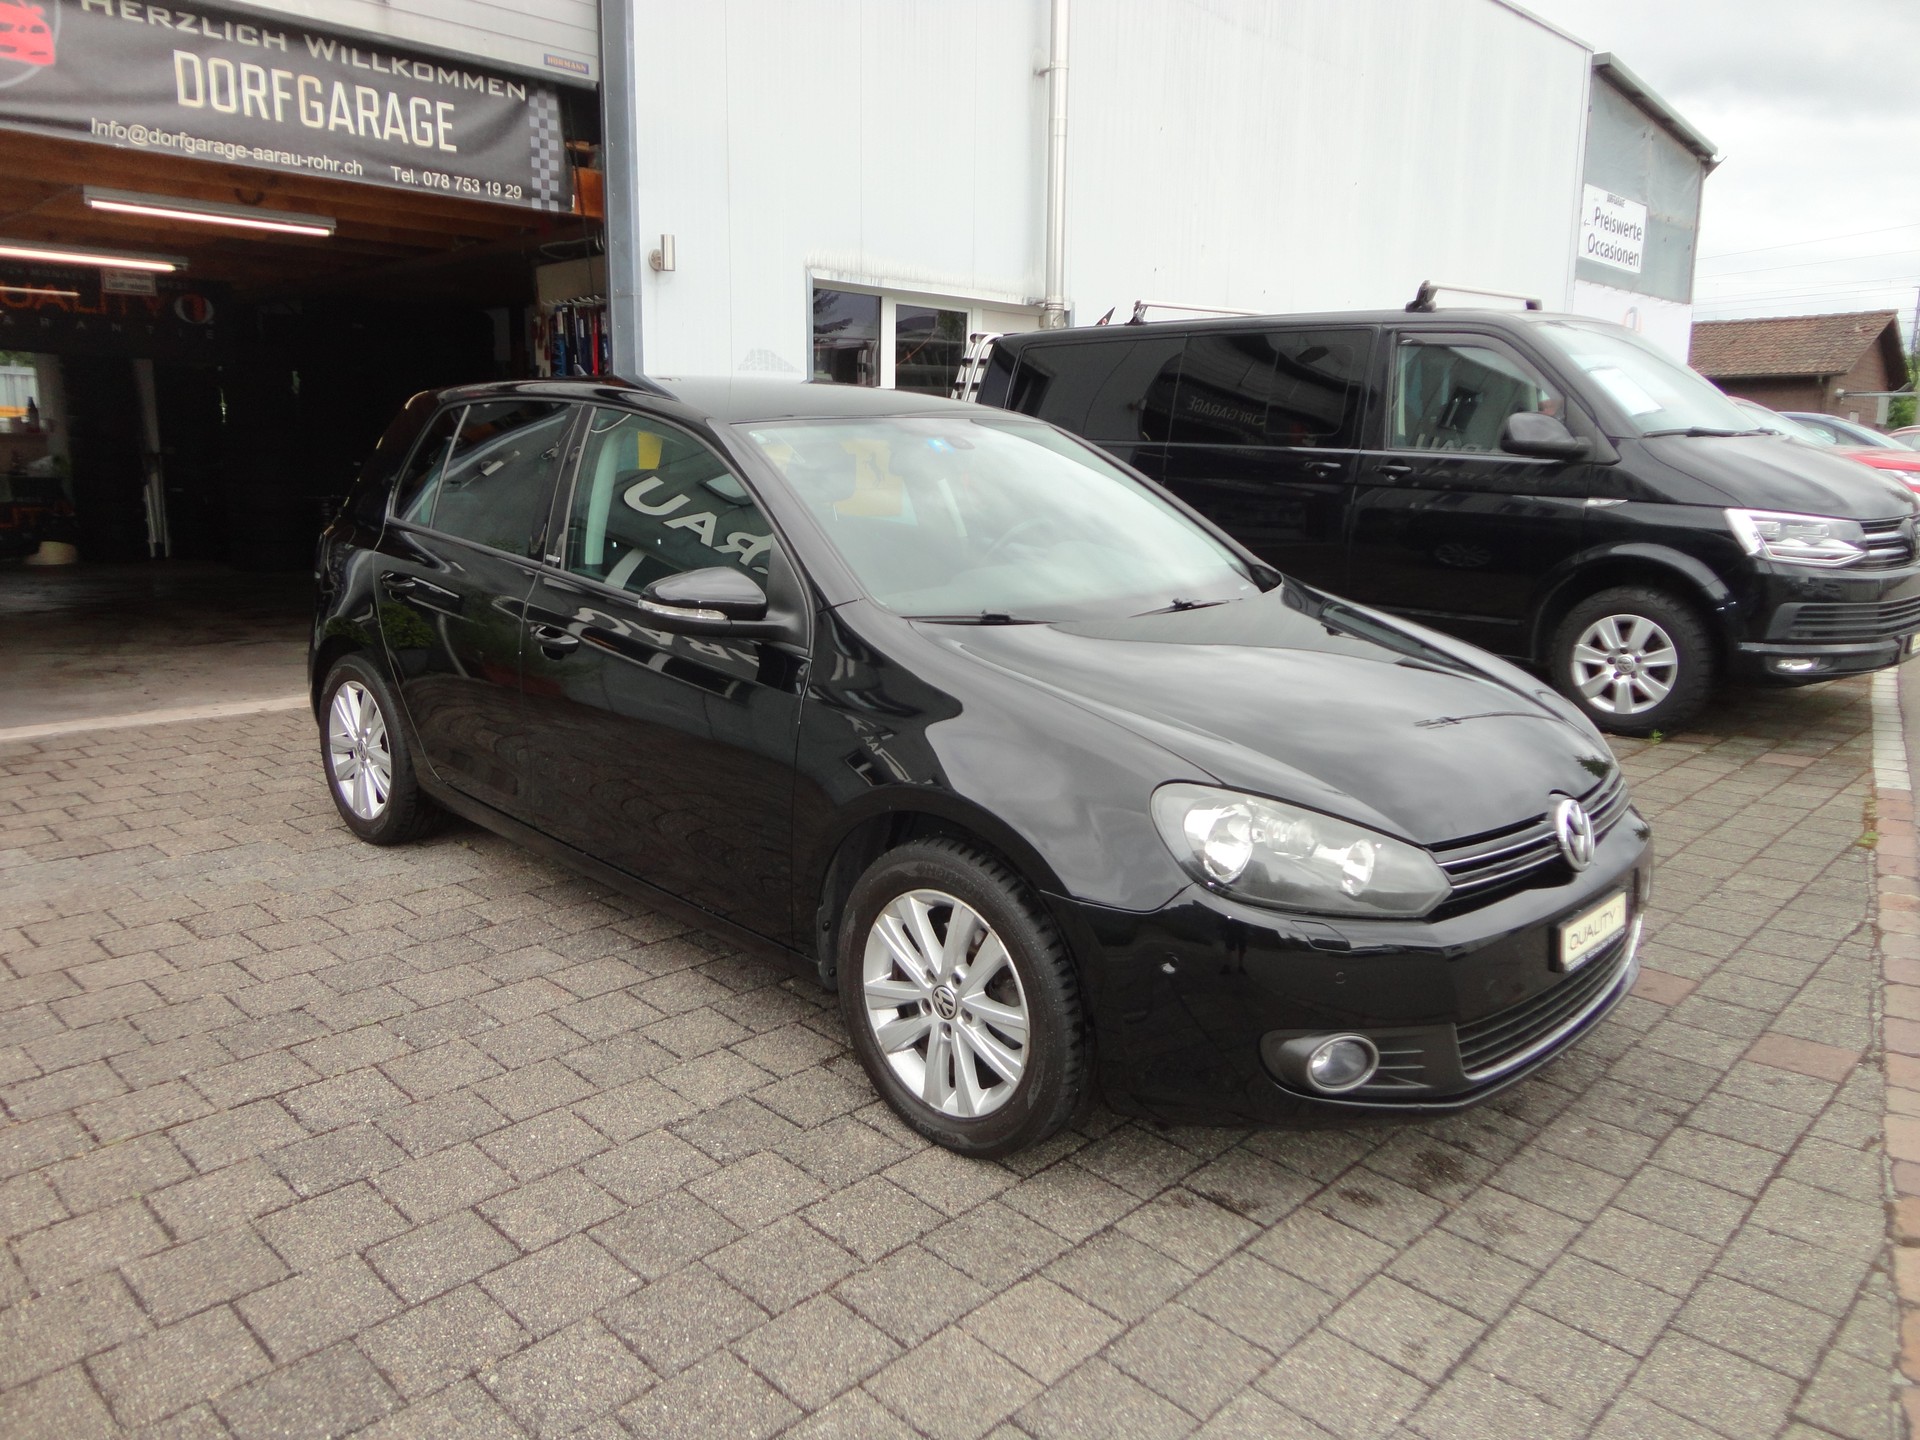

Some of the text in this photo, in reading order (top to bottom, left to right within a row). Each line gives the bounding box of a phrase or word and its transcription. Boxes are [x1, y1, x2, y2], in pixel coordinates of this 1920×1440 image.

[303, 33, 526, 101] WILLKOMMEN
[173, 49, 457, 153] DORFGARAGE
[90, 117, 363, 177] Info@dorfgarage-aarau-rohr.ch
[390, 165, 523, 200] Tel. 078 753 19 29
[1594, 206, 1643, 242] Preiswerte
[1587, 232, 1640, 267] Occasionen
[1570, 907, 1617, 951] QUALITY
